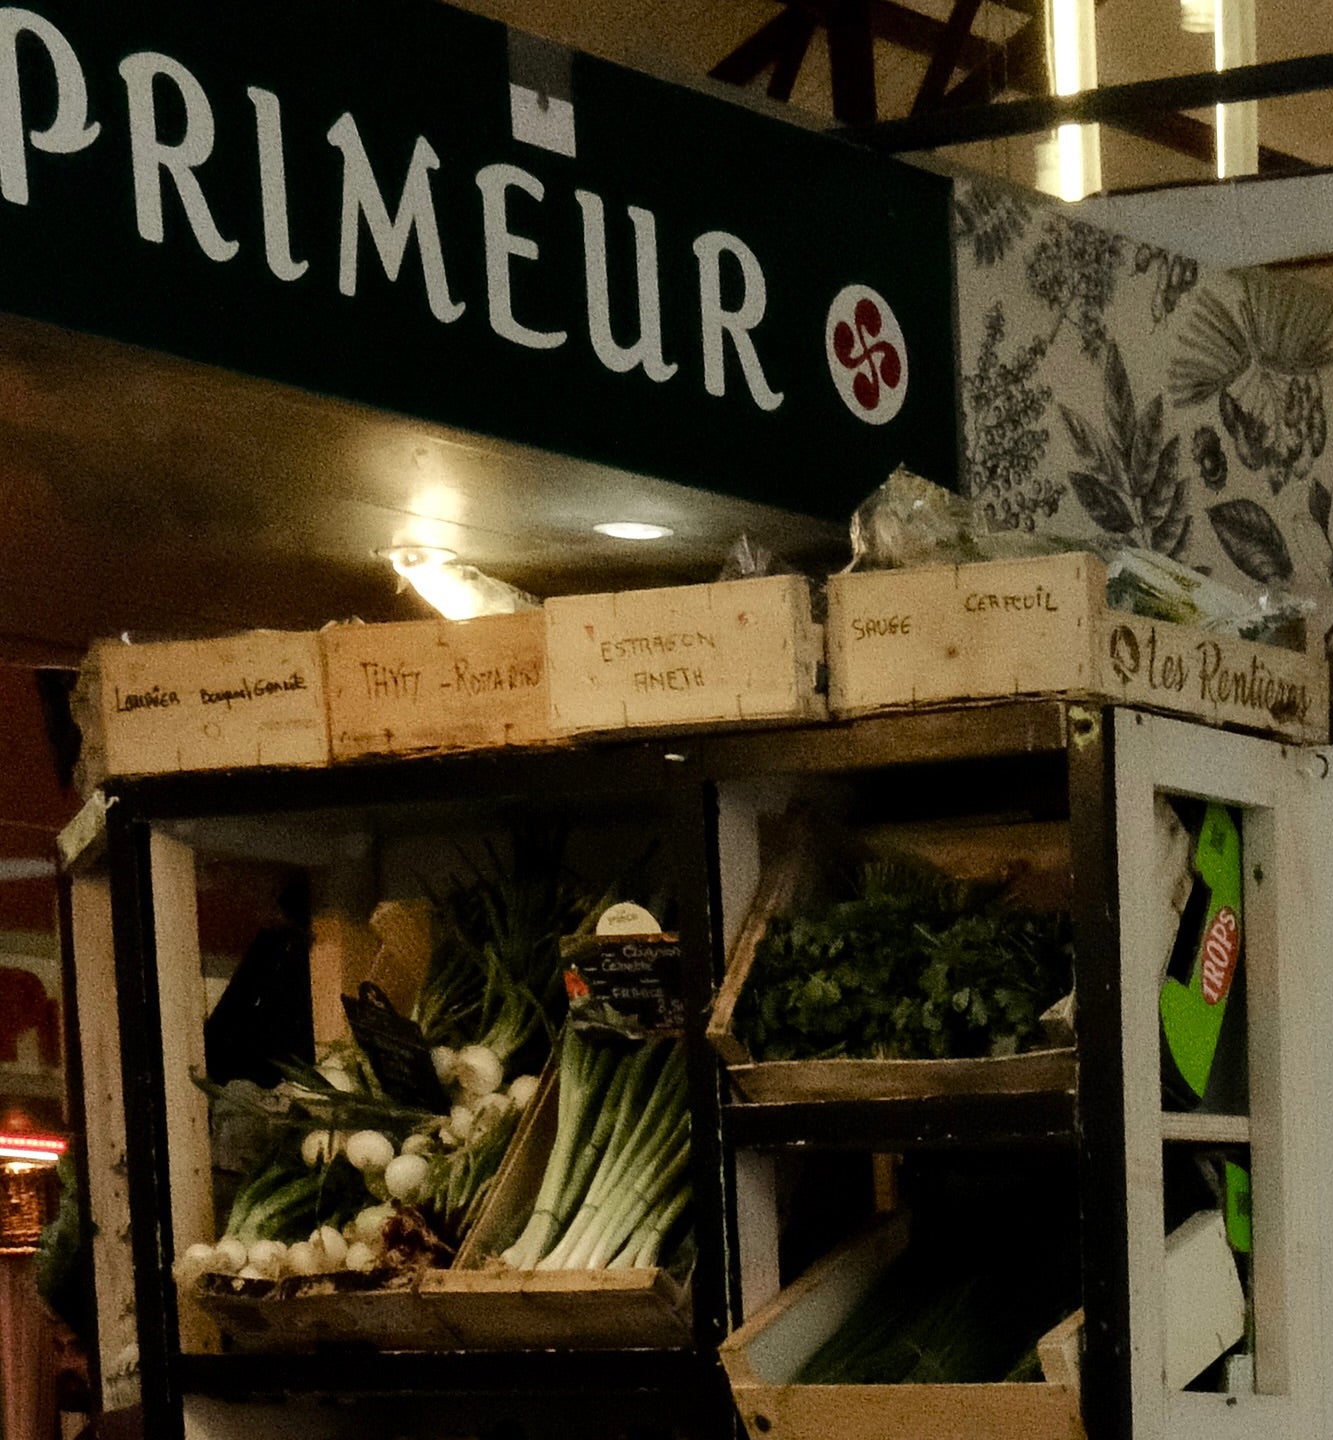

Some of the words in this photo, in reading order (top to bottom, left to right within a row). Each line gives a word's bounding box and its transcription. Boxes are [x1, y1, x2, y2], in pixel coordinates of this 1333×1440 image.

[0, 6, 784, 412] PRIMEUR
[599, 631, 717, 663] ESTRAGON
[634, 666, 706, 694] ANETH
